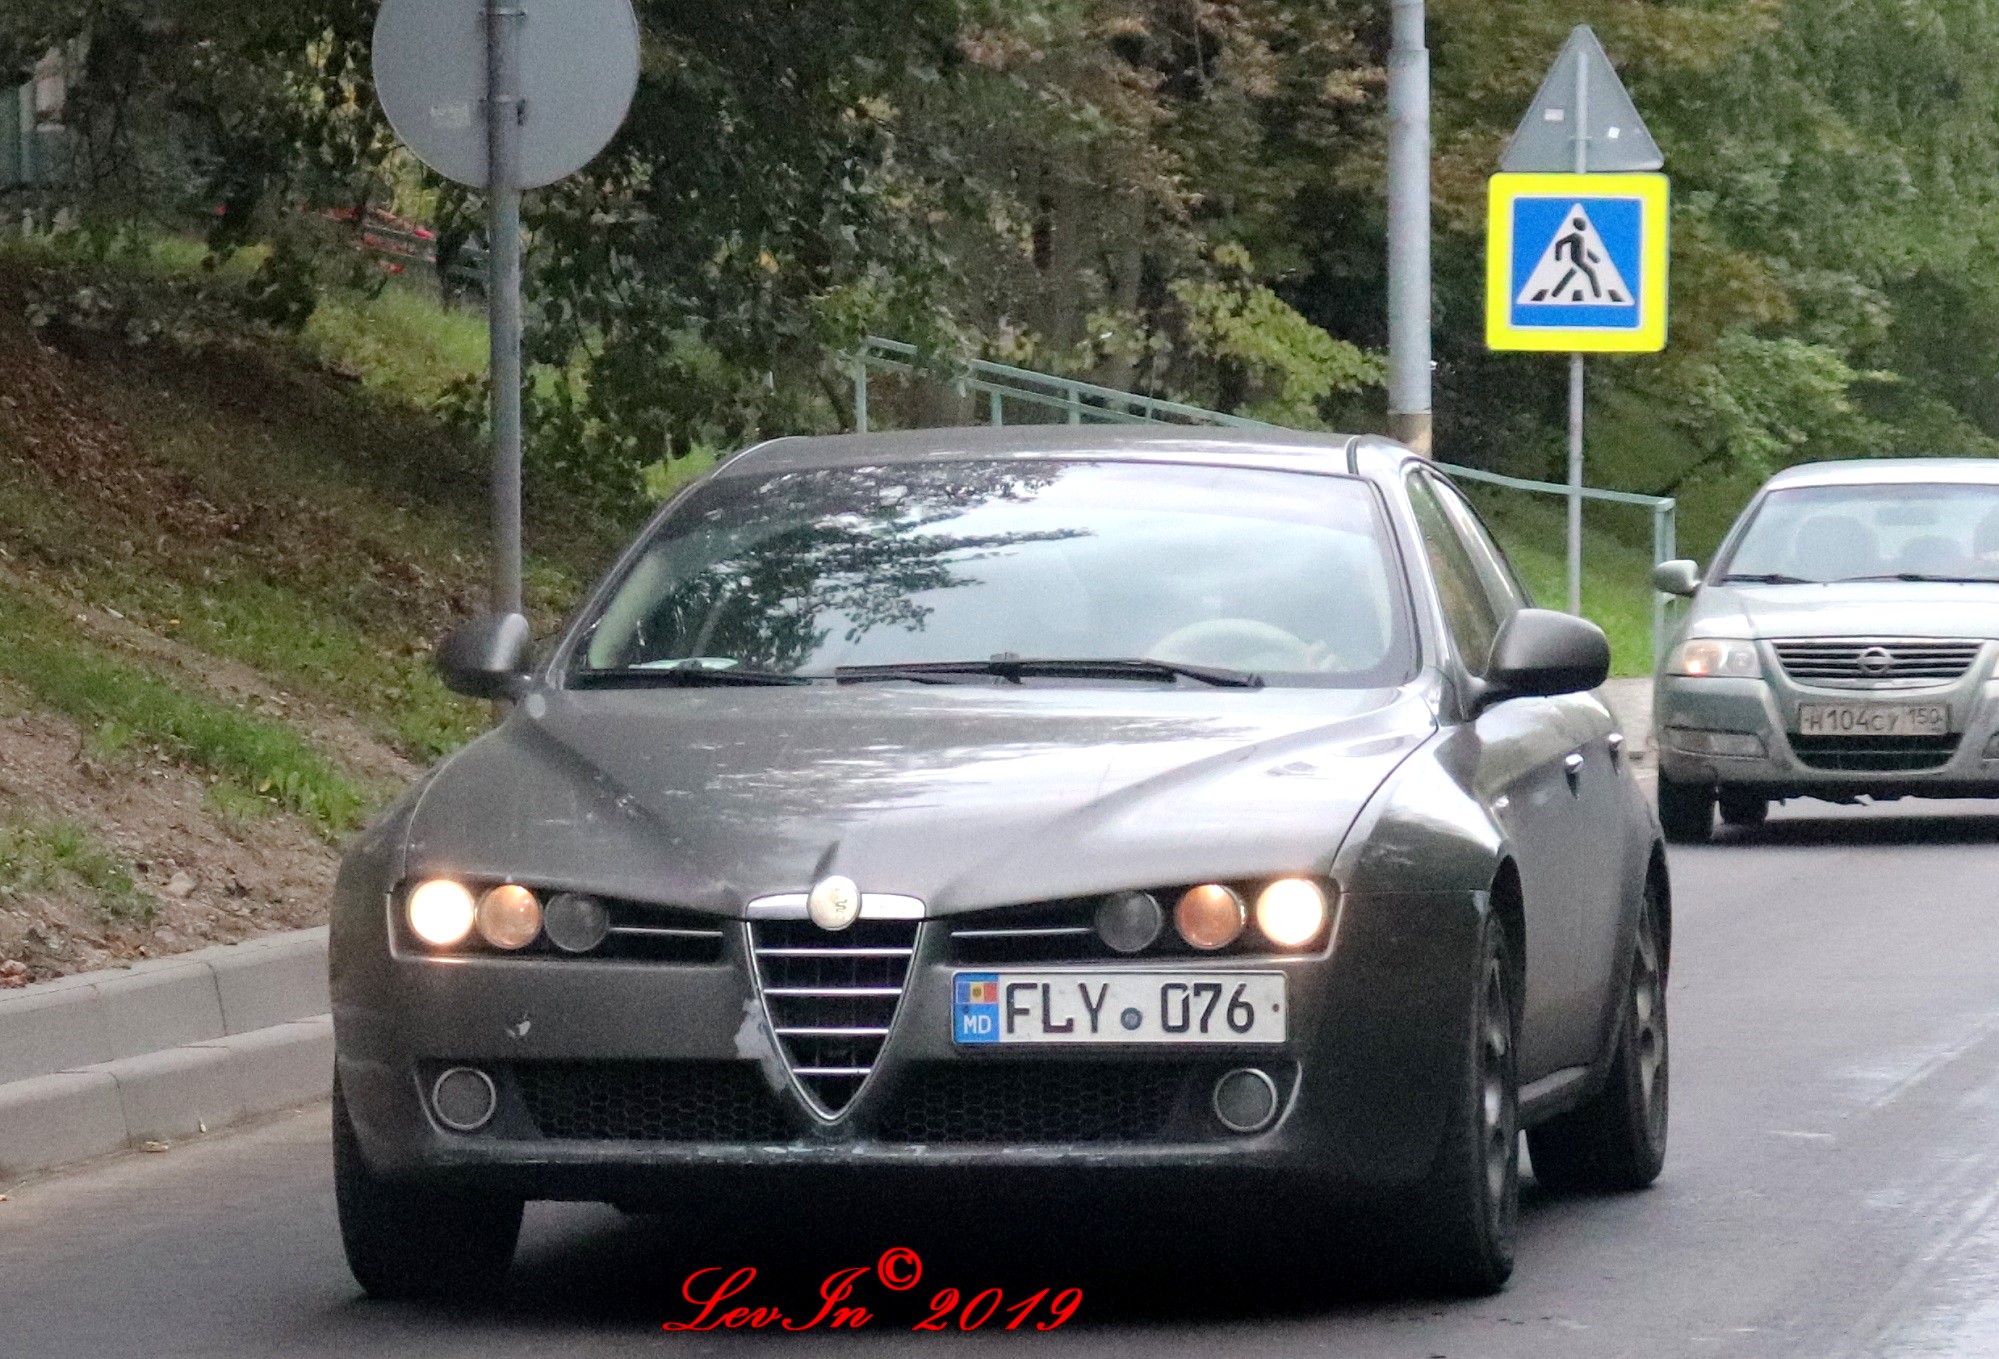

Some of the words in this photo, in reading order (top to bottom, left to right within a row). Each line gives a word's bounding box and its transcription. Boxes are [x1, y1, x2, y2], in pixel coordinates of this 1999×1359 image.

[962, 1014, 992, 1034] MD
[1005, 981, 1109, 1034] FLY
[1160, 981, 1255, 1034] 076
